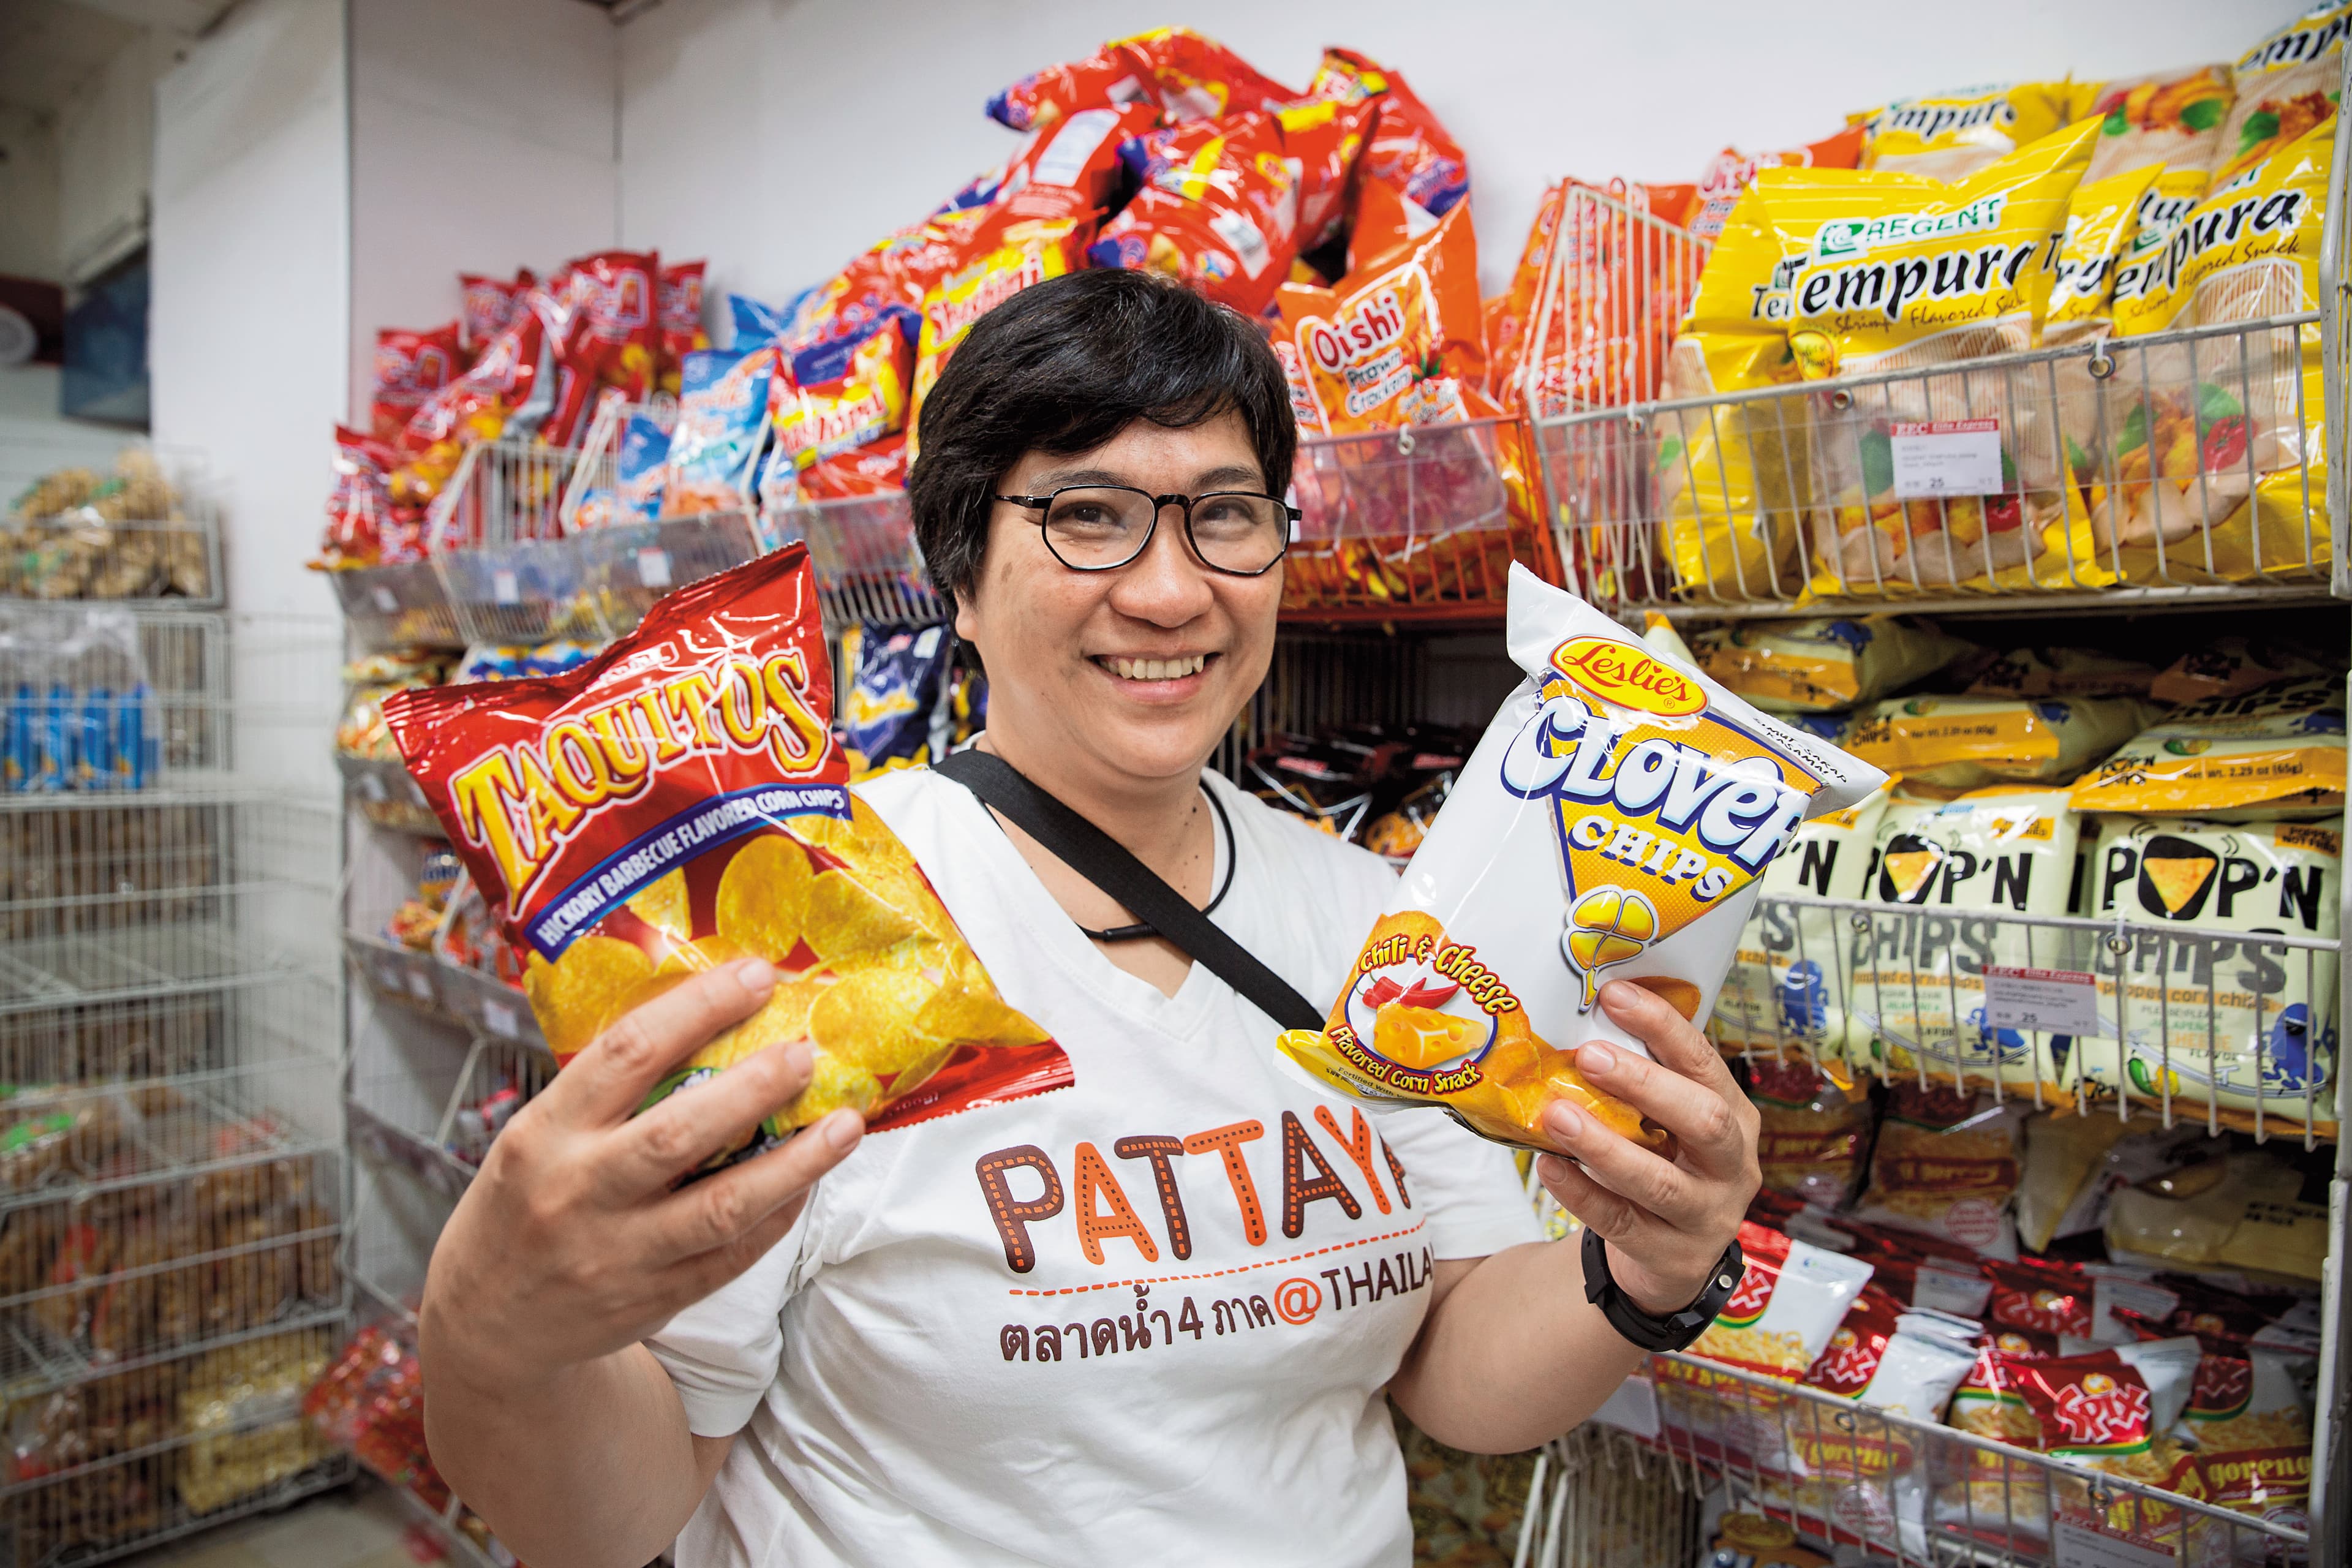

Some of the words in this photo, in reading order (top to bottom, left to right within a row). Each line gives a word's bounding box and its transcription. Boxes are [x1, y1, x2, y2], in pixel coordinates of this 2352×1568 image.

[1868, 198, 2002, 243] REGENT
[1314, 295, 1401, 368] Oishi
[1911, 298, 1988, 327] Flavored
[1930, 477, 1945, 489] 25
[1563, 644, 1689, 703] Leslie's
[453, 650, 829, 914] TAQUITOS
[2229, 767, 2254, 778] 2.29
[539, 886, 605, 944] HICKORY
[600, 830, 684, 899] BARBECUE
[677, 794, 760, 850] FLAVORED
[758, 789, 801, 815] CORN
[799, 786, 845, 812] CHIPS
[1569, 815, 1733, 903] CHIPS
[2103, 835, 2324, 931] POP'N
[1416, 936, 1433, 963] &
[1436, 944, 1519, 1014] Cheese
[2022, 1012, 2038, 1023] 25
[1330, 1027, 1397, 1085] Flavored
[1390, 1068, 1429, 1094] Corn
[1434, 1062, 1482, 1094] Snack
[2054, 1382, 2151, 1443] SPIX
